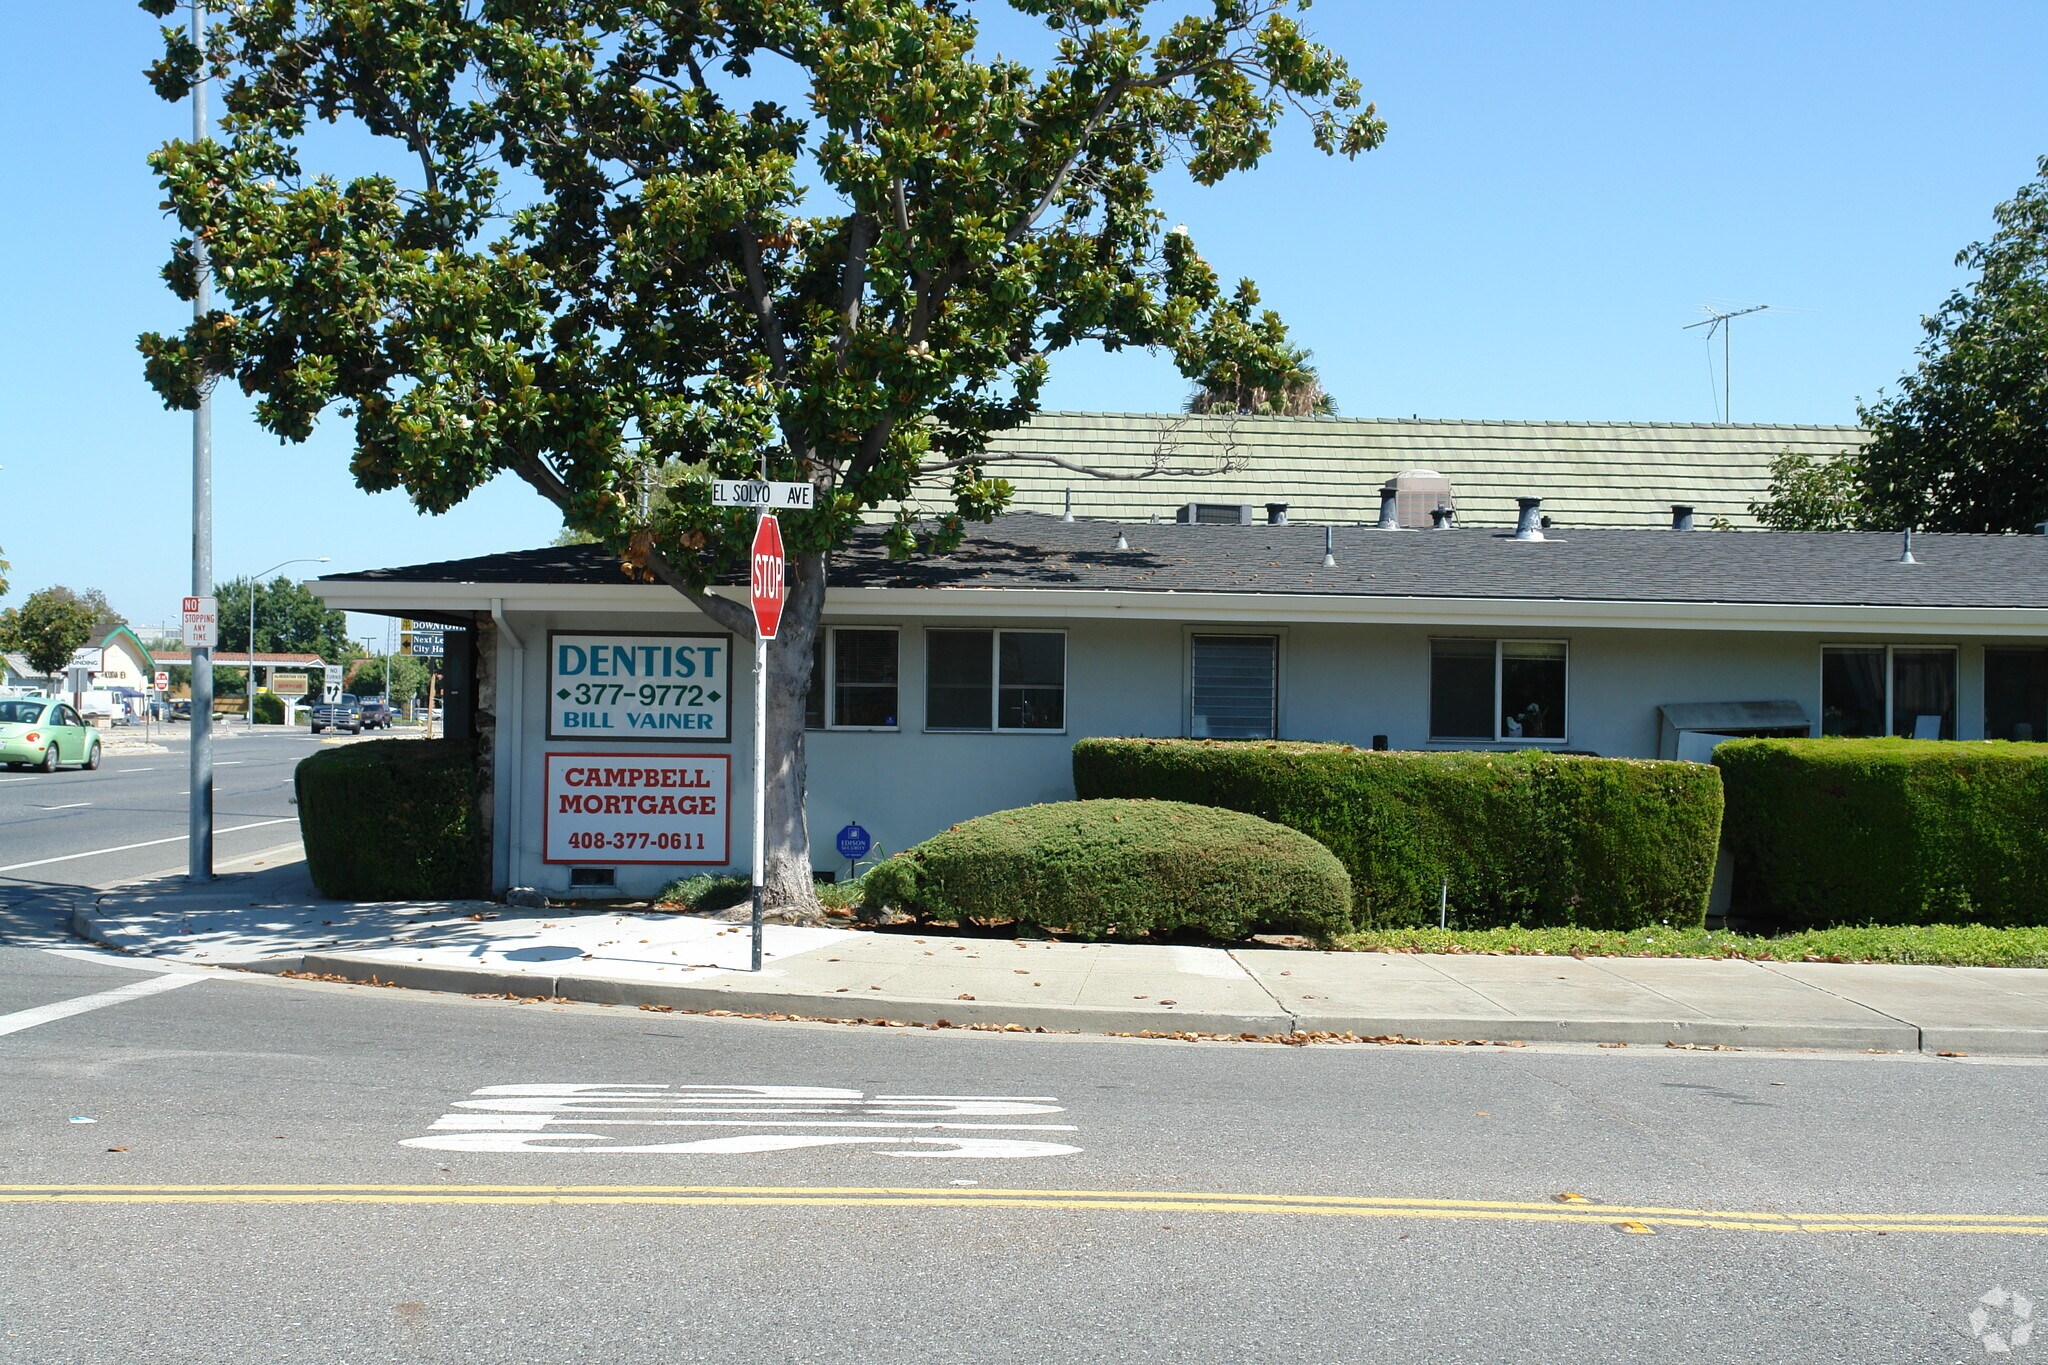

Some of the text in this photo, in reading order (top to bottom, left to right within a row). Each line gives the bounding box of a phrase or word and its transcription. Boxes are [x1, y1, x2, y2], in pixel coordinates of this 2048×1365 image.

[713, 483, 727, 501] EL
[733, 484, 770, 503] SOLYO
[754, 553, 782, 599] STOP
[184, 599, 196, 611] NO
[184, 613, 215, 624] STOPPING
[193, 624, 206, 632] ANY
[192, 633, 207, 641] TIME
[413, 635, 432, 644] Next
[413, 644, 430, 654] City
[558, 644, 722, 678] DENTIST
[574, 683, 704, 706] 377-9772
[563, 711, 714, 730] BILL VAINER
[565, 767, 711, 788] CAMPBELL
[559, 794, 716, 815] MORTGAGE
[568, 831, 705, 850] 408-377-0611
